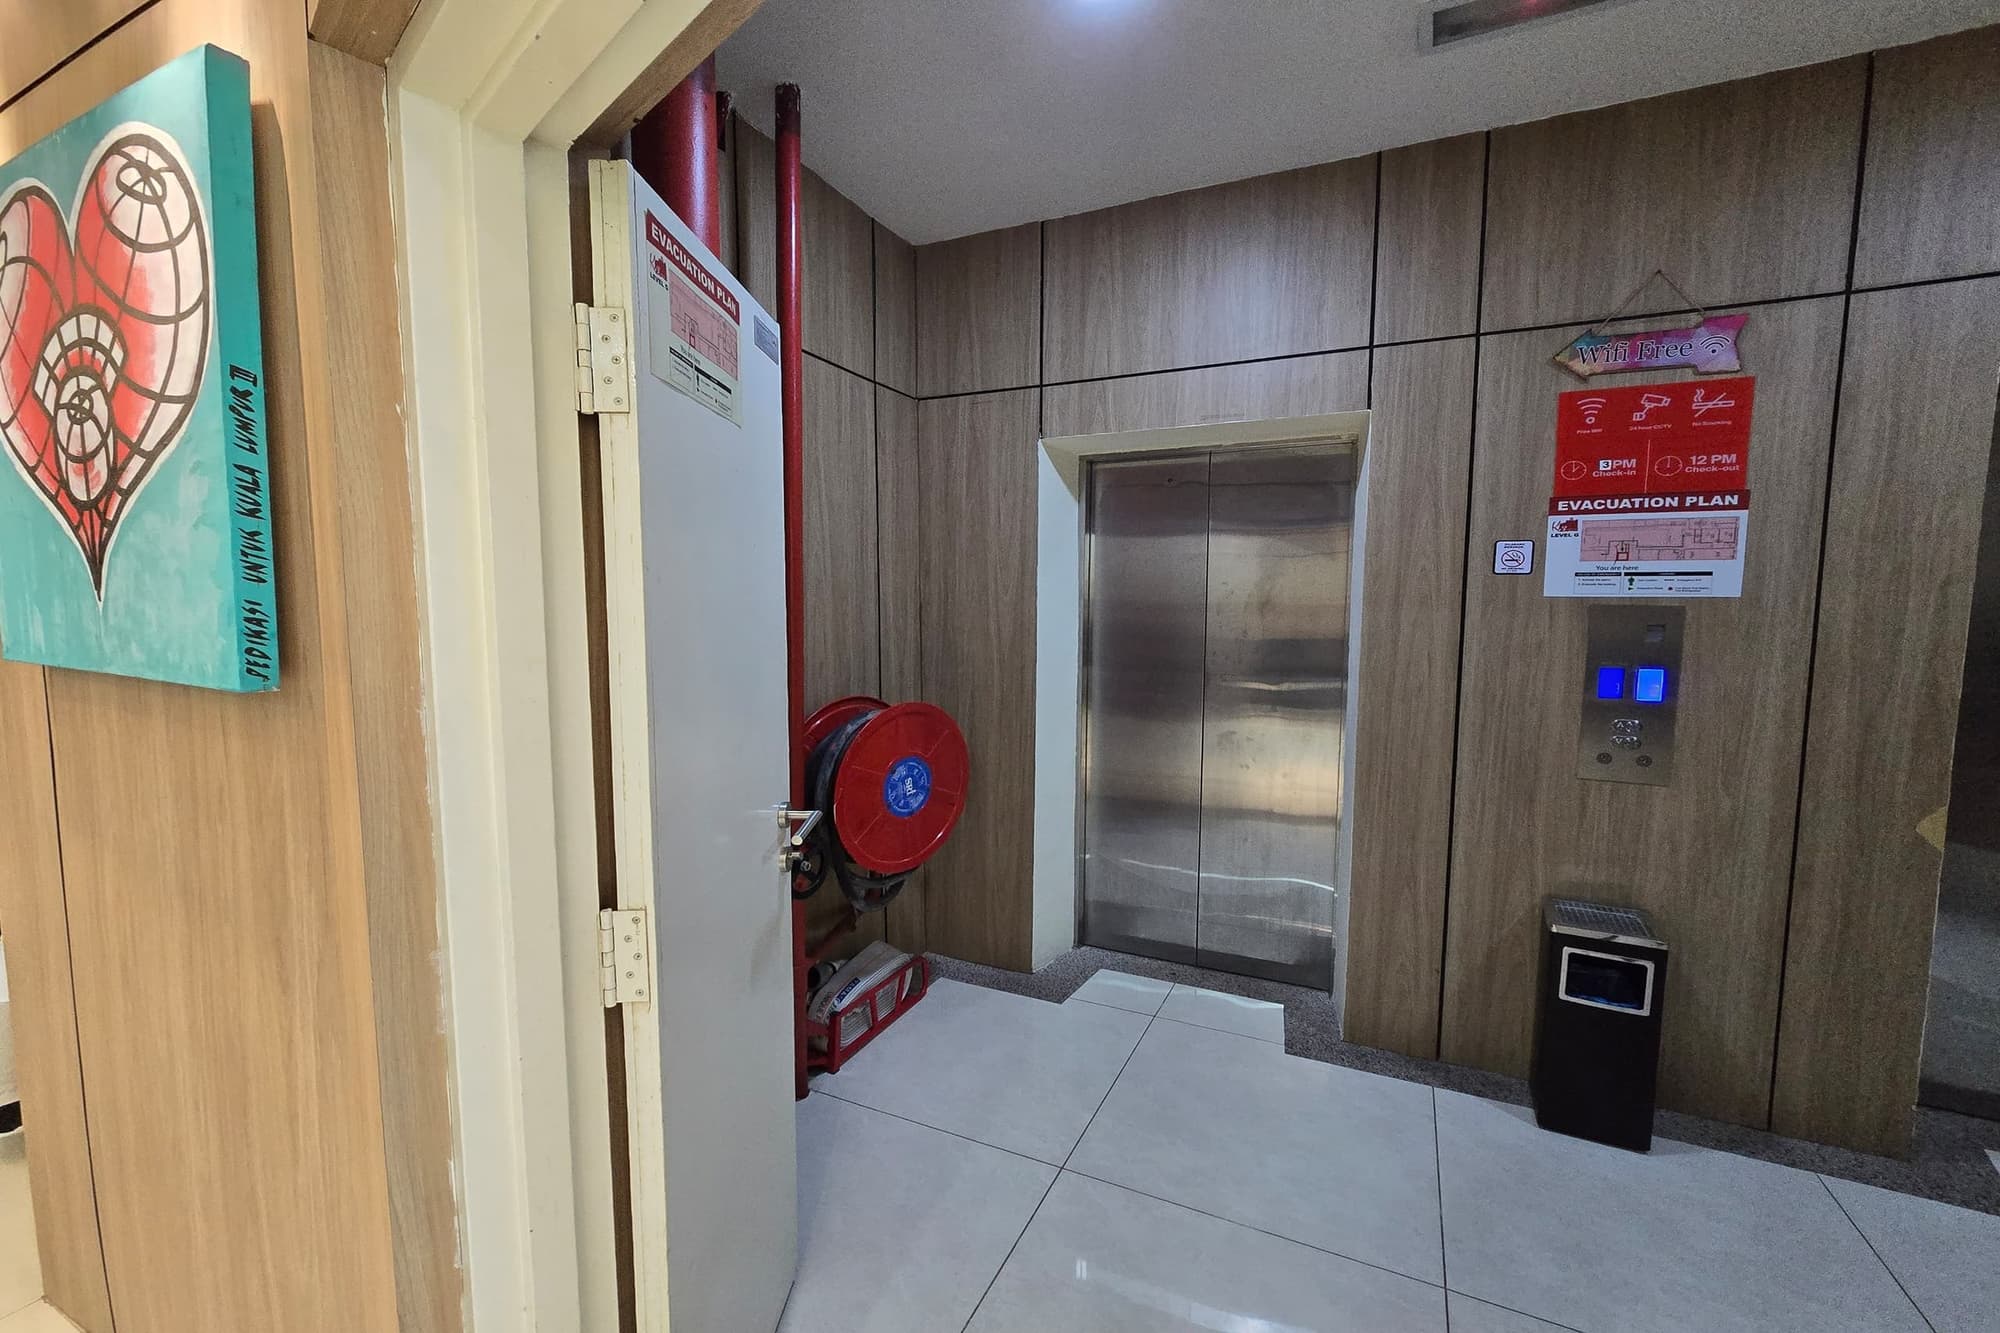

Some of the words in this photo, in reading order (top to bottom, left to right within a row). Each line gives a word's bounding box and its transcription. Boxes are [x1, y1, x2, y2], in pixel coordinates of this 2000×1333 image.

[651, 223, 715, 295] EVACUATION
[716, 286, 737, 317] PLAN
[1578, 341, 1630, 365] Wifi
[1636, 338, 1694, 361] Free
[228, 385, 259, 456] LUMPUR
[1685, 465, 1740, 473] Check-out
[1690, 455, 1707, 465] 12
[1711, 454, 1737, 464] PM
[232, 462, 266, 521] KUALA
[1557, 497, 1679, 512] EVACUATION
[1685, 494, 1739, 507] PLAN
[239, 527, 271, 585] UNTUK
